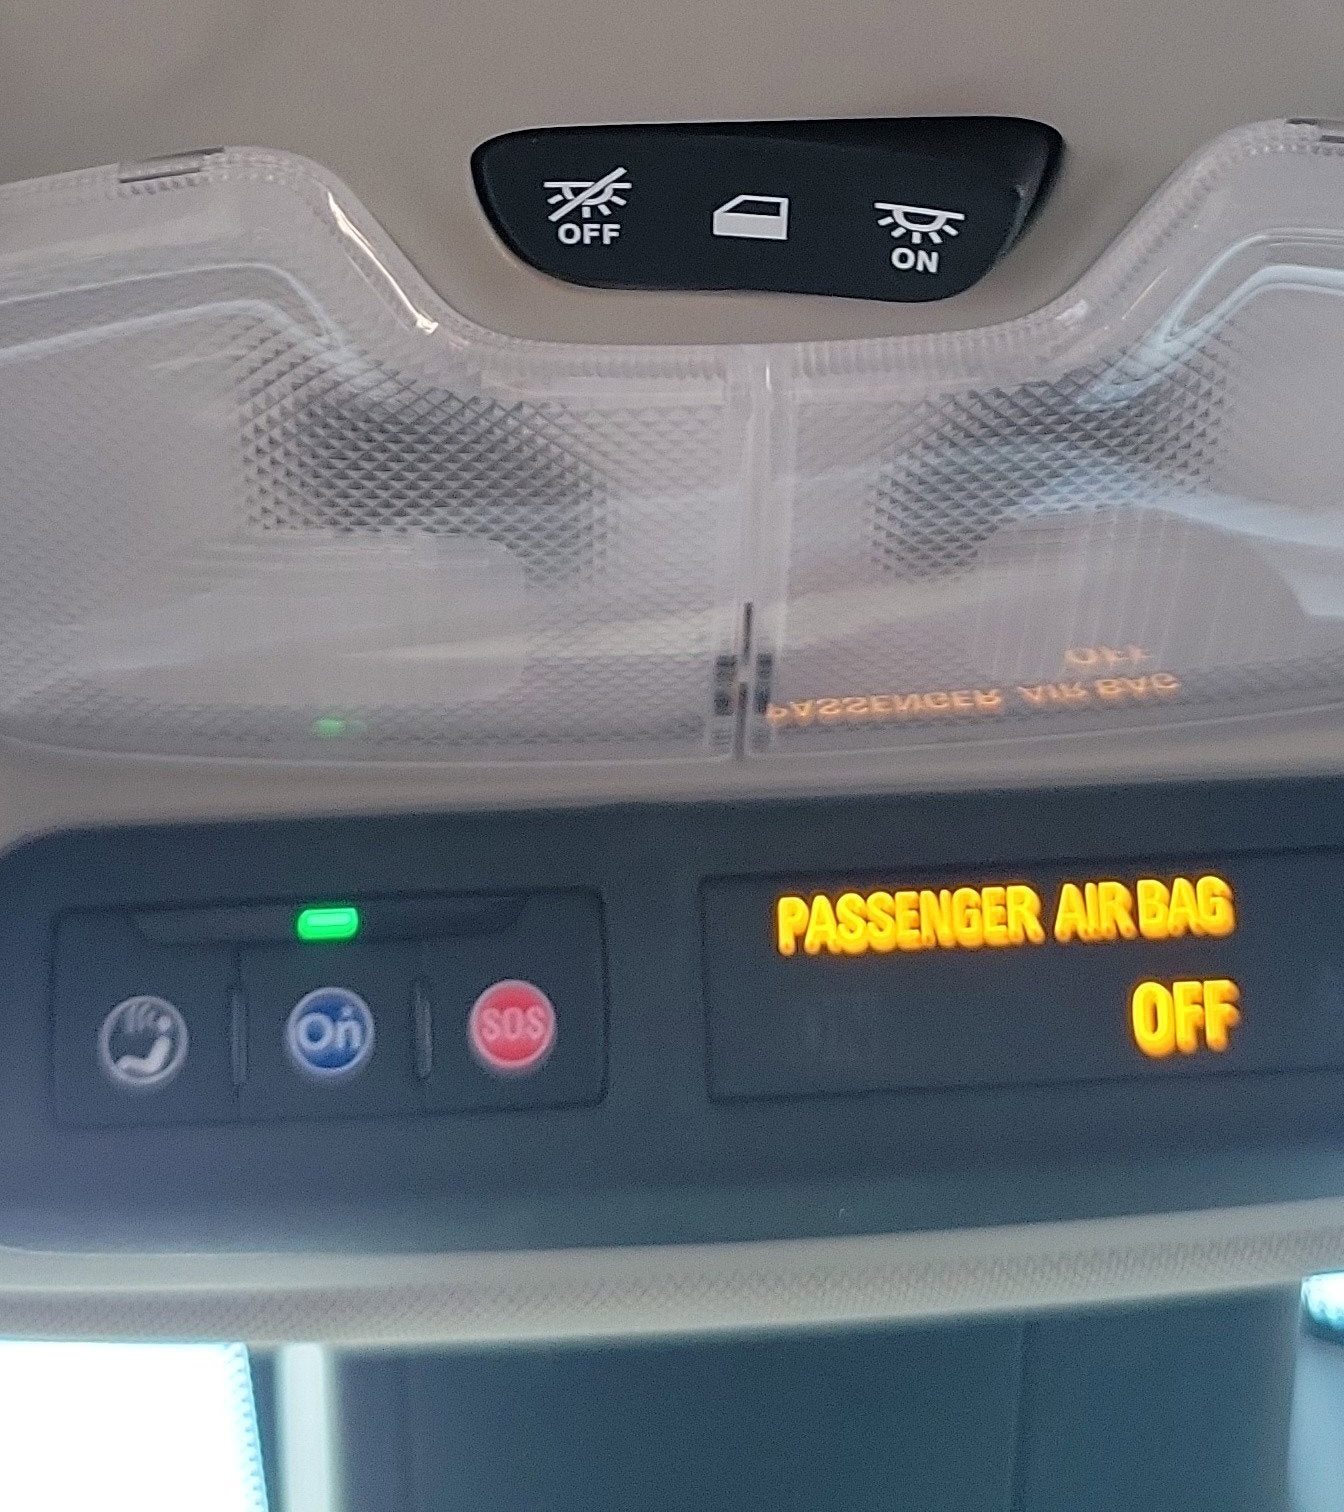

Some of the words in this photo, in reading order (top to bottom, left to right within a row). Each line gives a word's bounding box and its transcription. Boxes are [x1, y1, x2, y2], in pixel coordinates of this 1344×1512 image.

[557, 222, 621, 246] OFF
[890, 246, 939, 274] ON
[777, 884, 1046, 956] PASSENGER
[481, 1004, 546, 1043] SOS
[1131, 978, 1241, 1059] OFF
